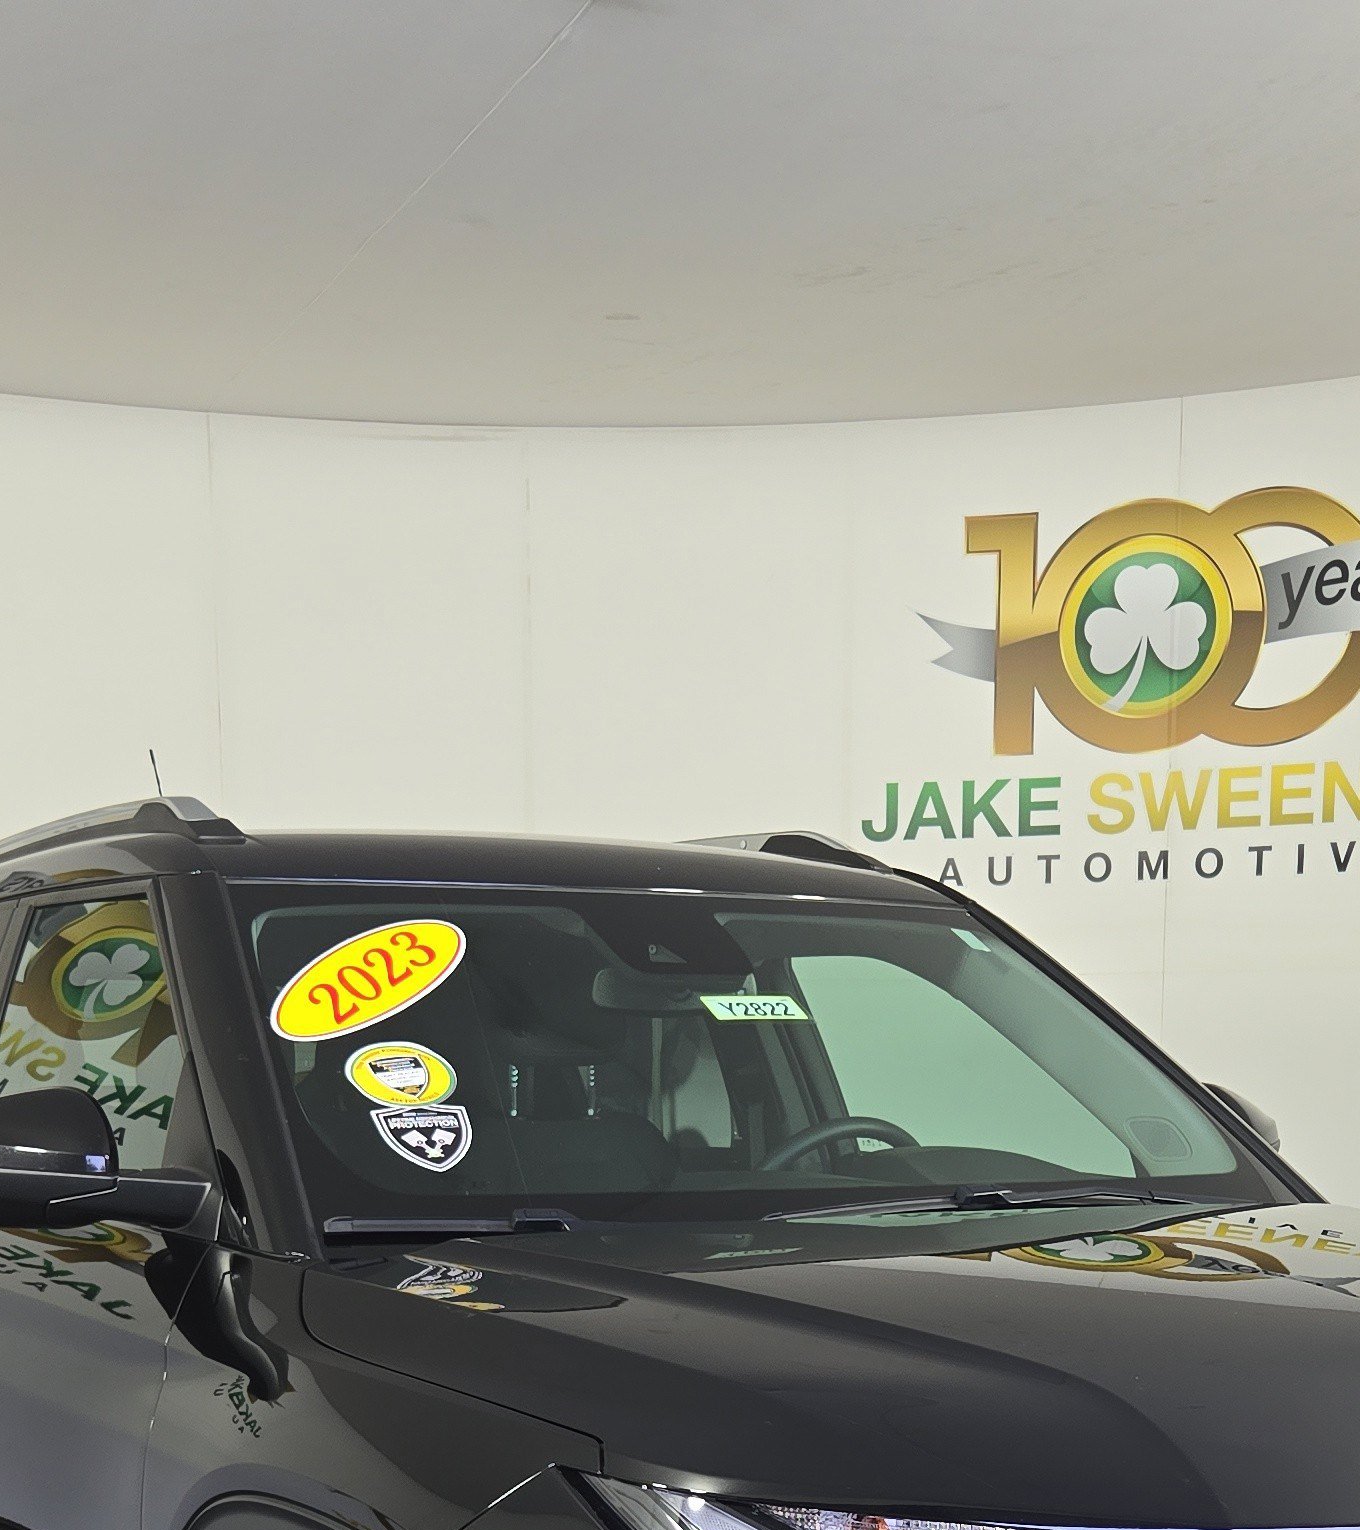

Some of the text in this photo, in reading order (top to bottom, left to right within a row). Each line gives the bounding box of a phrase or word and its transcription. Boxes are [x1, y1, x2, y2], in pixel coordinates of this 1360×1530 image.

[861, 776, 1062, 842] JAKE
[308, 931, 436, 1025] 2023
[718, 1003, 795, 1016] Y2822
